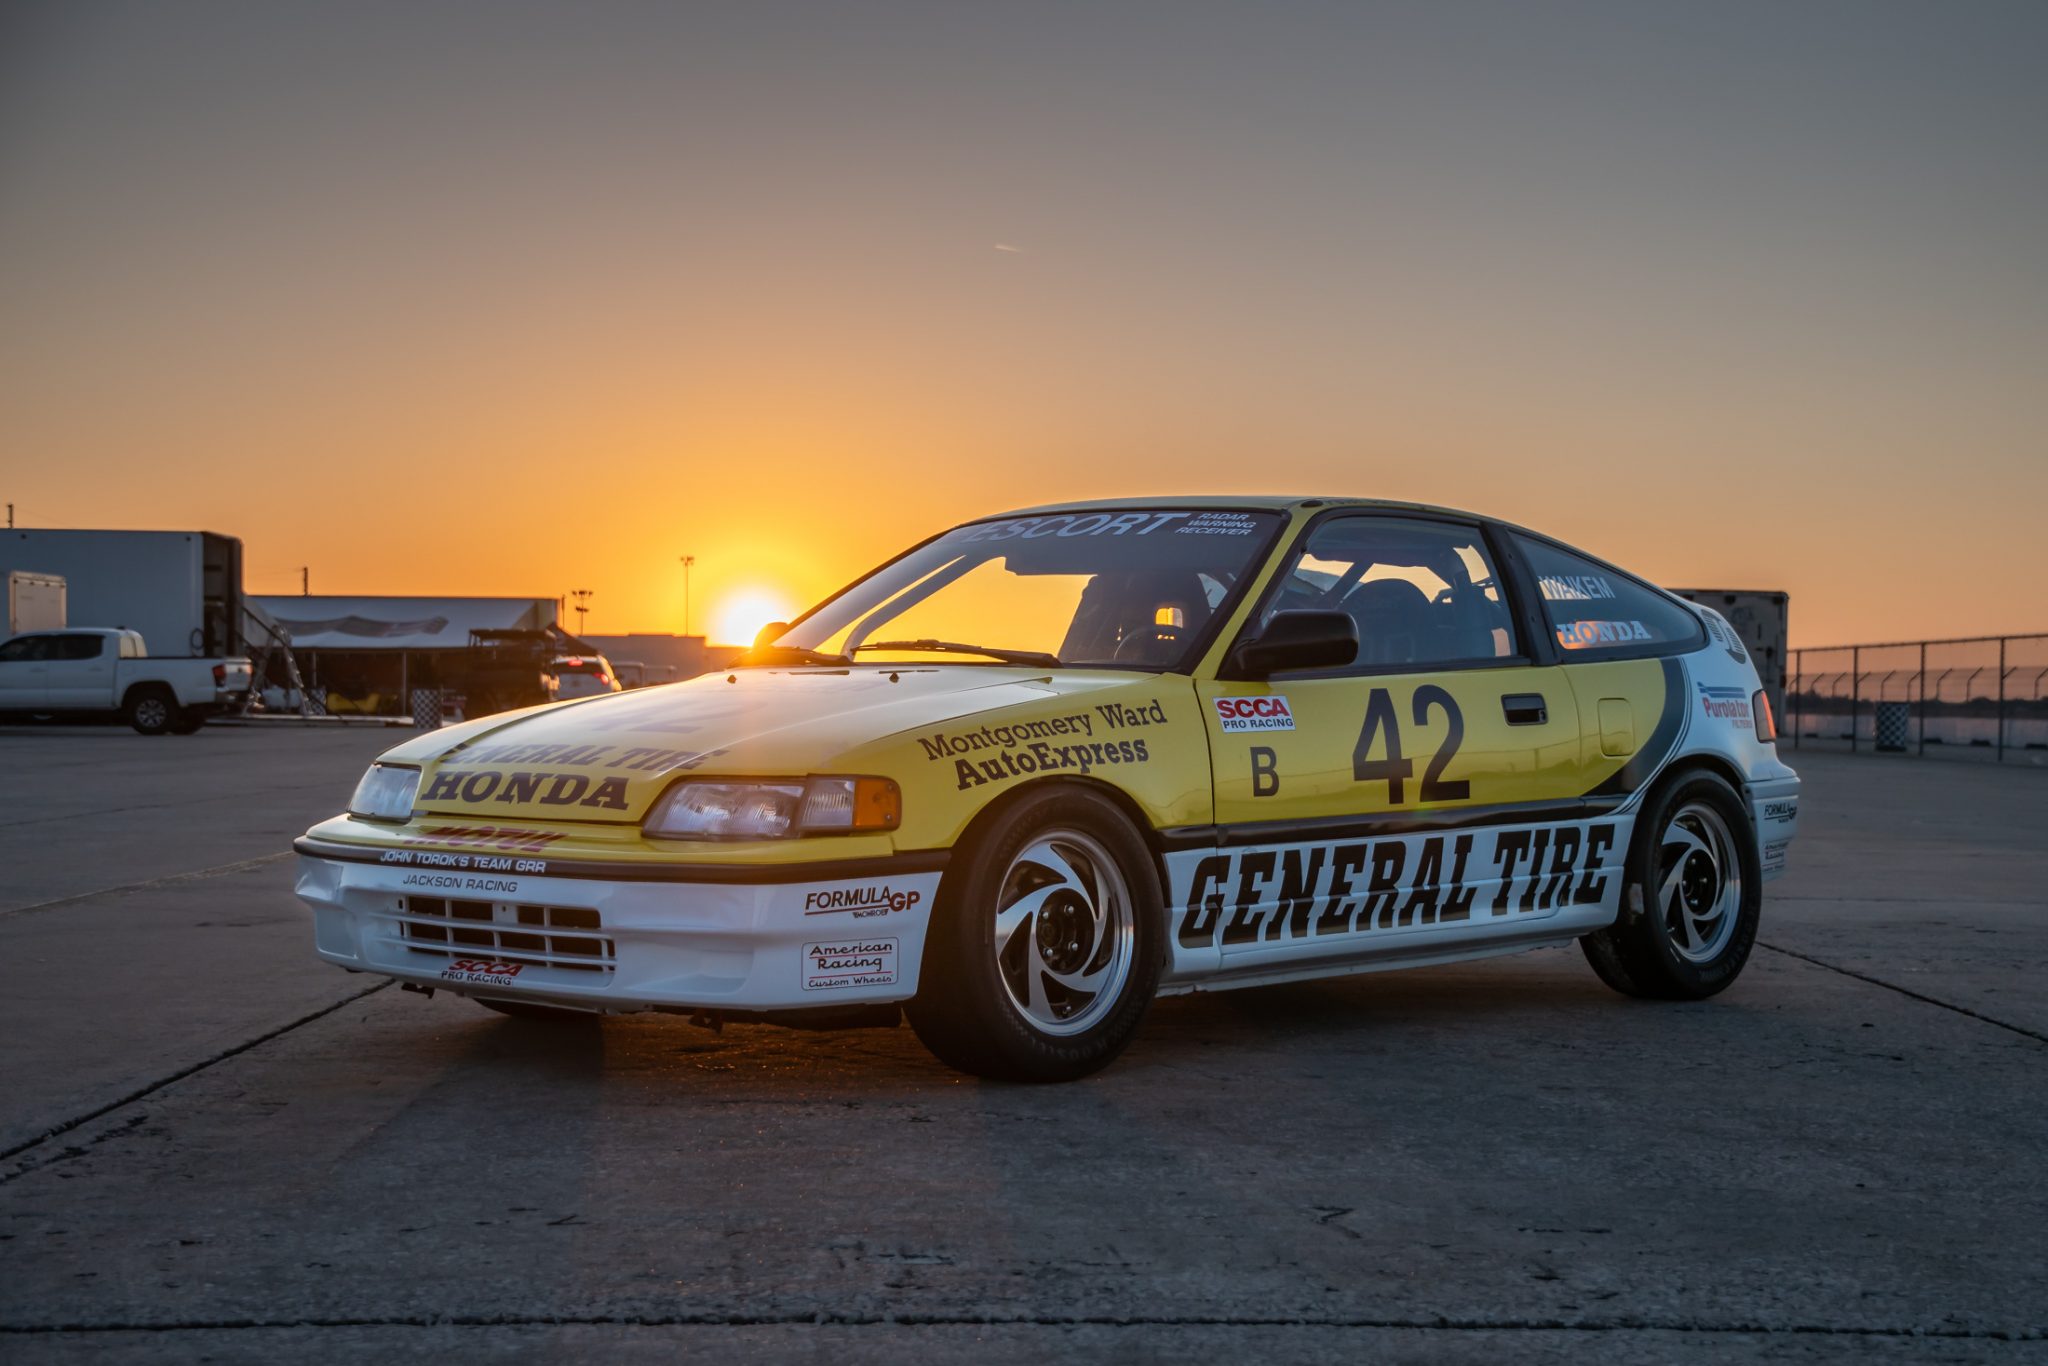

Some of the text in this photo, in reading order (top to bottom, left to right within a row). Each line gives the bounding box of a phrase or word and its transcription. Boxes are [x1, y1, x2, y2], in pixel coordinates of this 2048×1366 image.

[961, 513, 1192, 543] ESCORT
[1188, 520, 1257, 529] WARNING
[1199, 513, 1250, 521] RADAR
[1175, 527, 1253, 536] RECEIVER
[1555, 621, 1652, 645] HONDA
[1216, 698, 1291, 719] SCCA
[1702, 697, 1750, 718] Purolator
[917, 699, 1168, 762] Montgomery Ward
[1223, 718, 1295, 730] PRO RACING
[1352, 684, 1470, 805] 42
[425, 744, 729, 772] GENERAL TIRE
[954, 738, 1150, 791] AutoExpress
[1250, 746, 1280, 798] B
[420, 771, 630, 811] HONDA
[403, 826, 569, 853] MOTUL
[380, 849, 547, 873] JOHN TOROK'S TEAM GRR
[403, 874, 519, 893] JACKSON RACING
[1178, 823, 1616, 949] GENERAL TIRE
[804, 886, 891, 910] FORMULA
[809, 942, 893, 956] American
[448, 959, 524, 976] SCCA
[817, 957, 883, 972] Racing
[441, 970, 512, 986] PRO RACING
[809, 975, 893, 988] Custom Wheels
